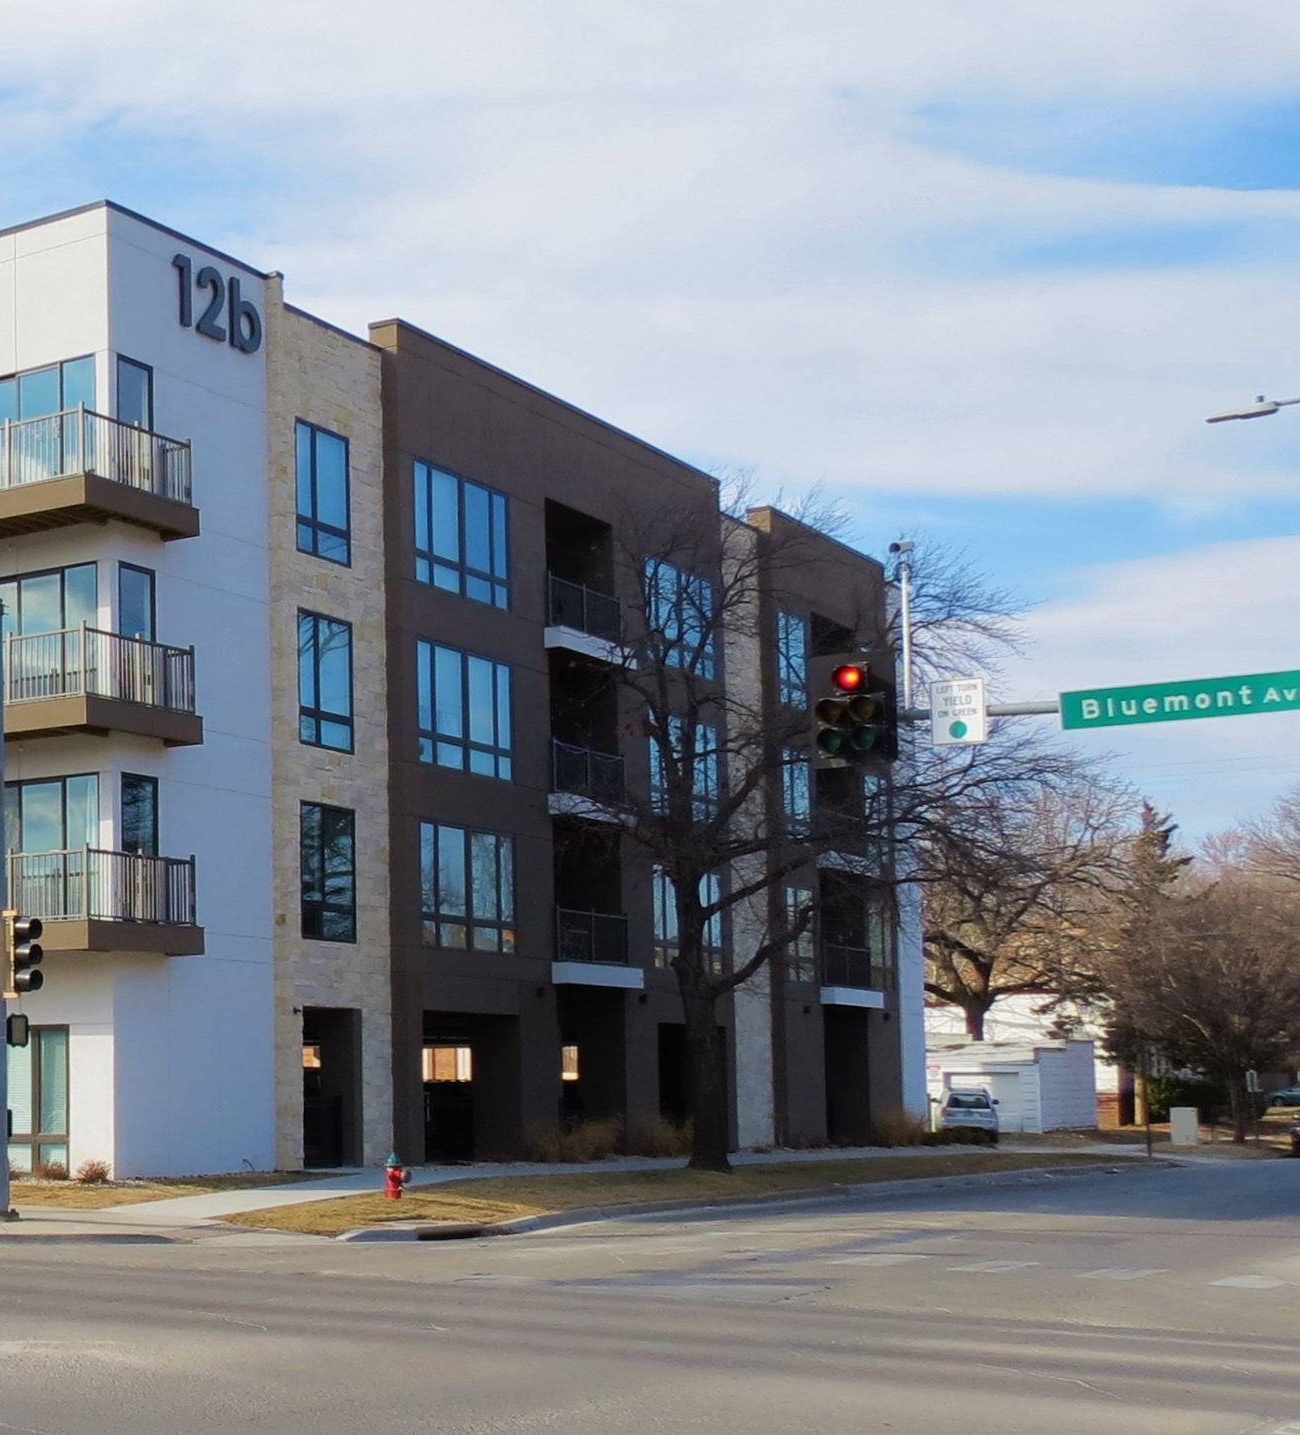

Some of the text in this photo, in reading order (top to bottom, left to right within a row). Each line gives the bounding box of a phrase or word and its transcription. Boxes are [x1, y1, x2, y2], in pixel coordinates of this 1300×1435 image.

[172, 254, 262, 354] 12b
[942, 695, 972, 707] YIELD
[1081, 685, 1252, 720] Bluemont
